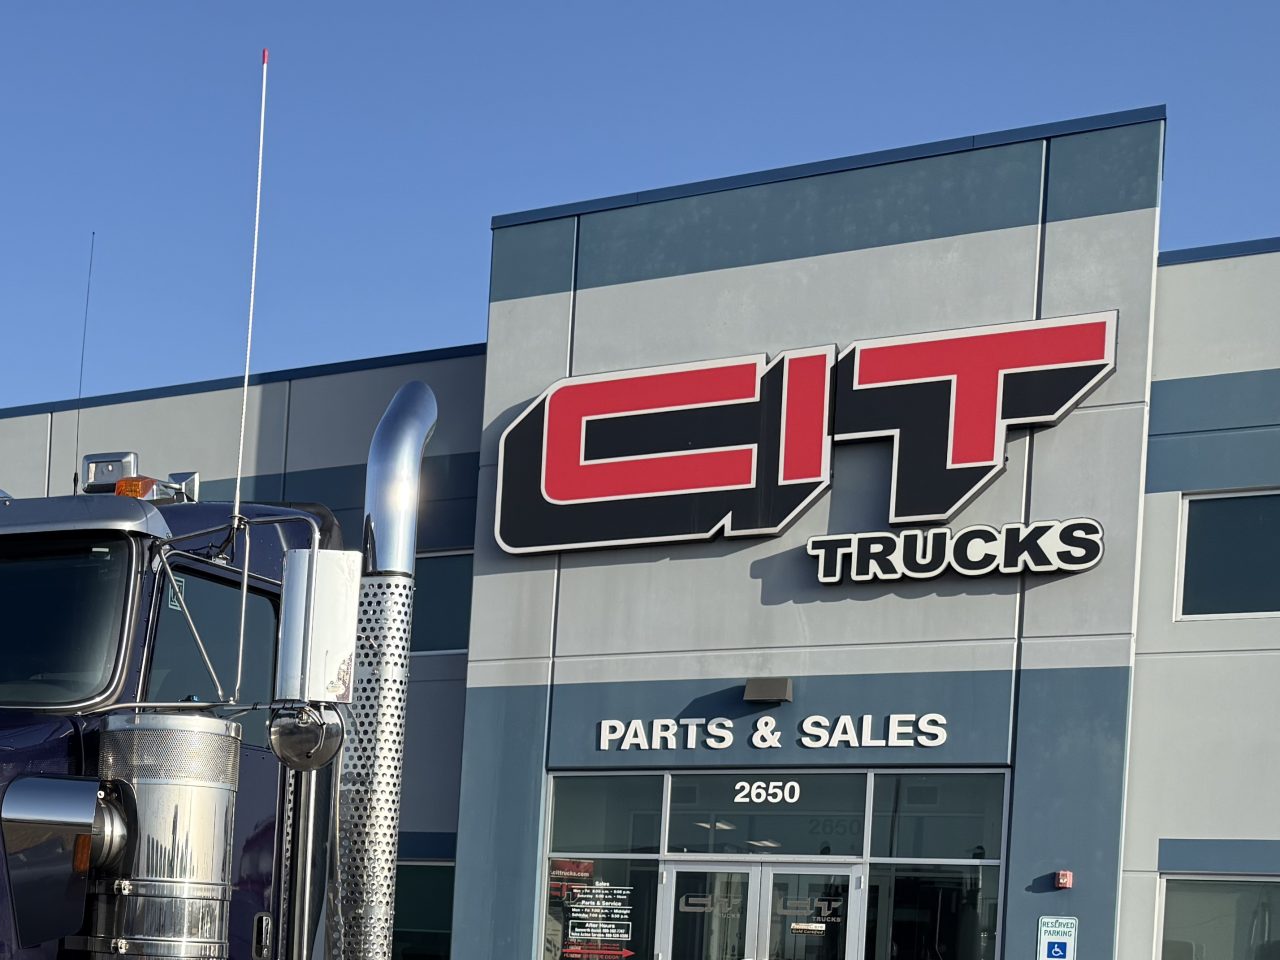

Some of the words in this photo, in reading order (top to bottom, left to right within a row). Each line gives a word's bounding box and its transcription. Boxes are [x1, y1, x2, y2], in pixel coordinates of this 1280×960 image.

[497, 310, 1119, 554] CIT
[808, 518, 1104, 584] TRUCKS
[599, 717, 734, 750] PARTS
[751, 716, 782, 749] &
[801, 713, 947, 748] SALES
[733, 781, 801, 803] 2650
[1042, 920, 1075, 929] RESERVED
